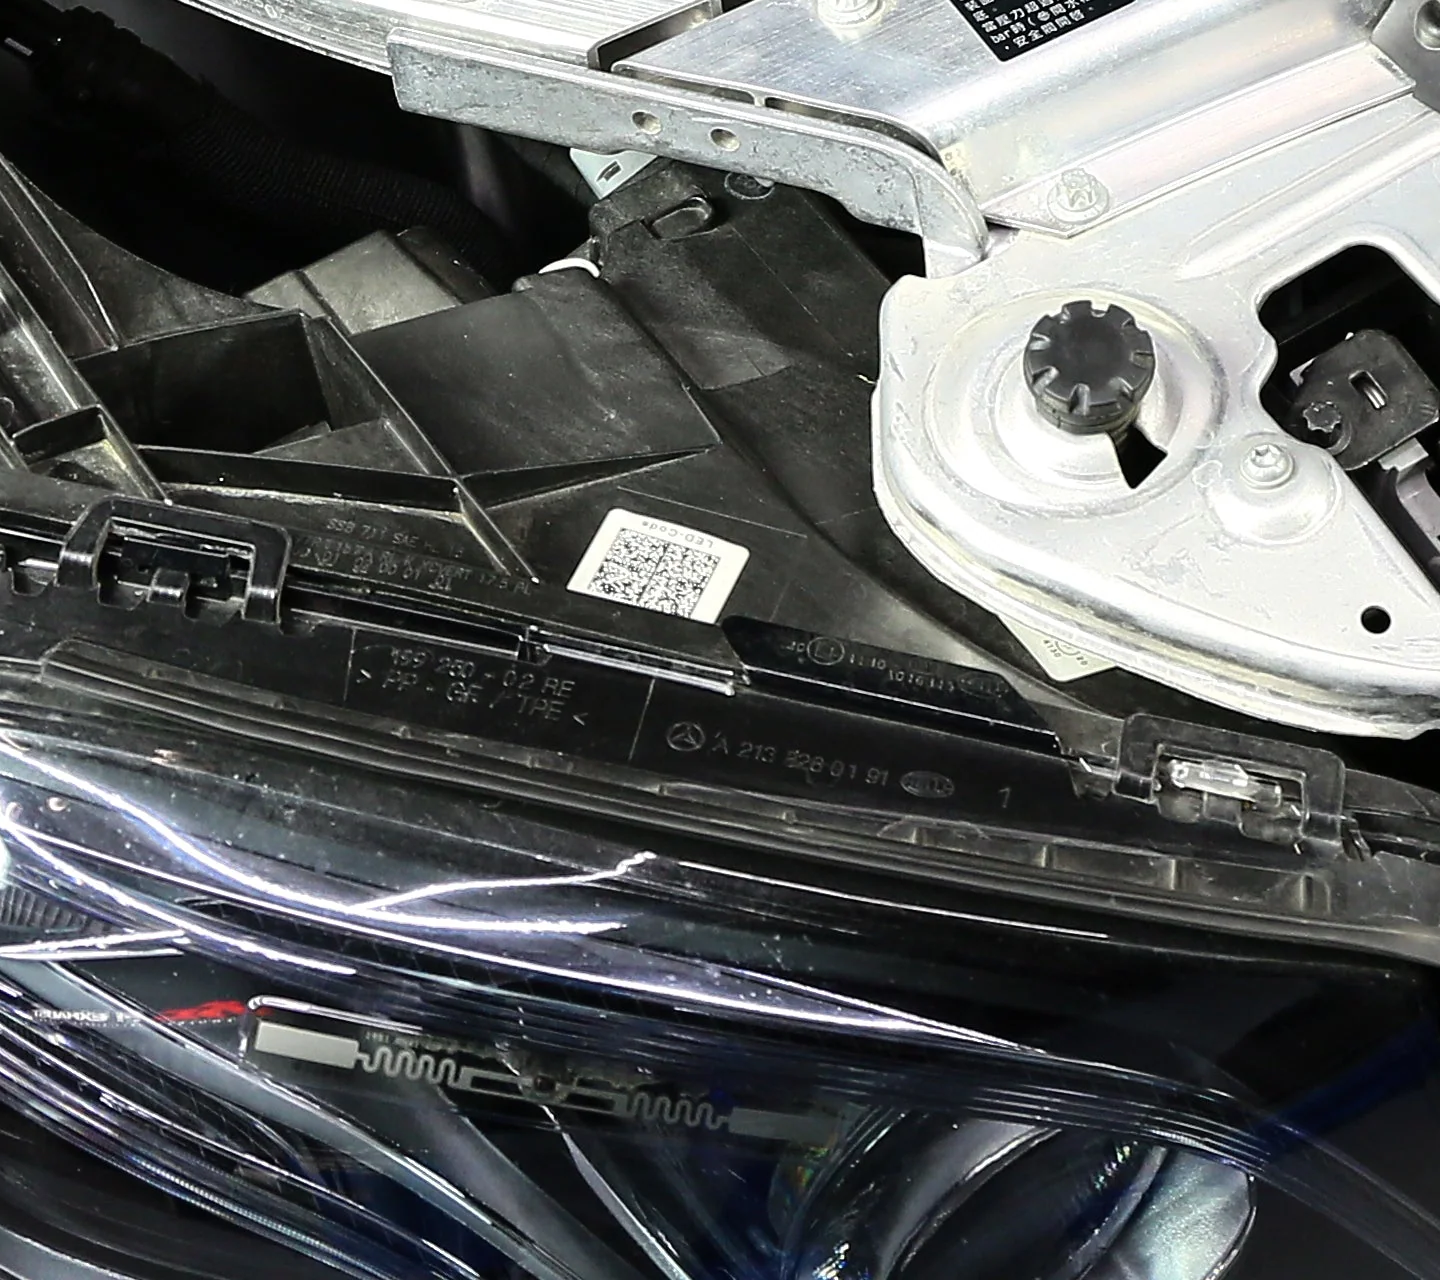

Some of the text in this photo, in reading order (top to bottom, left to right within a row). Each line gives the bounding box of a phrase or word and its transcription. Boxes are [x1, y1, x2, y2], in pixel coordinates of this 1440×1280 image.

[640, 520, 715, 546] LED-Code
[540, 676, 575, 698] RE
[514, 693, 564, 721] TPE
[737, 741, 774, 762] 213
